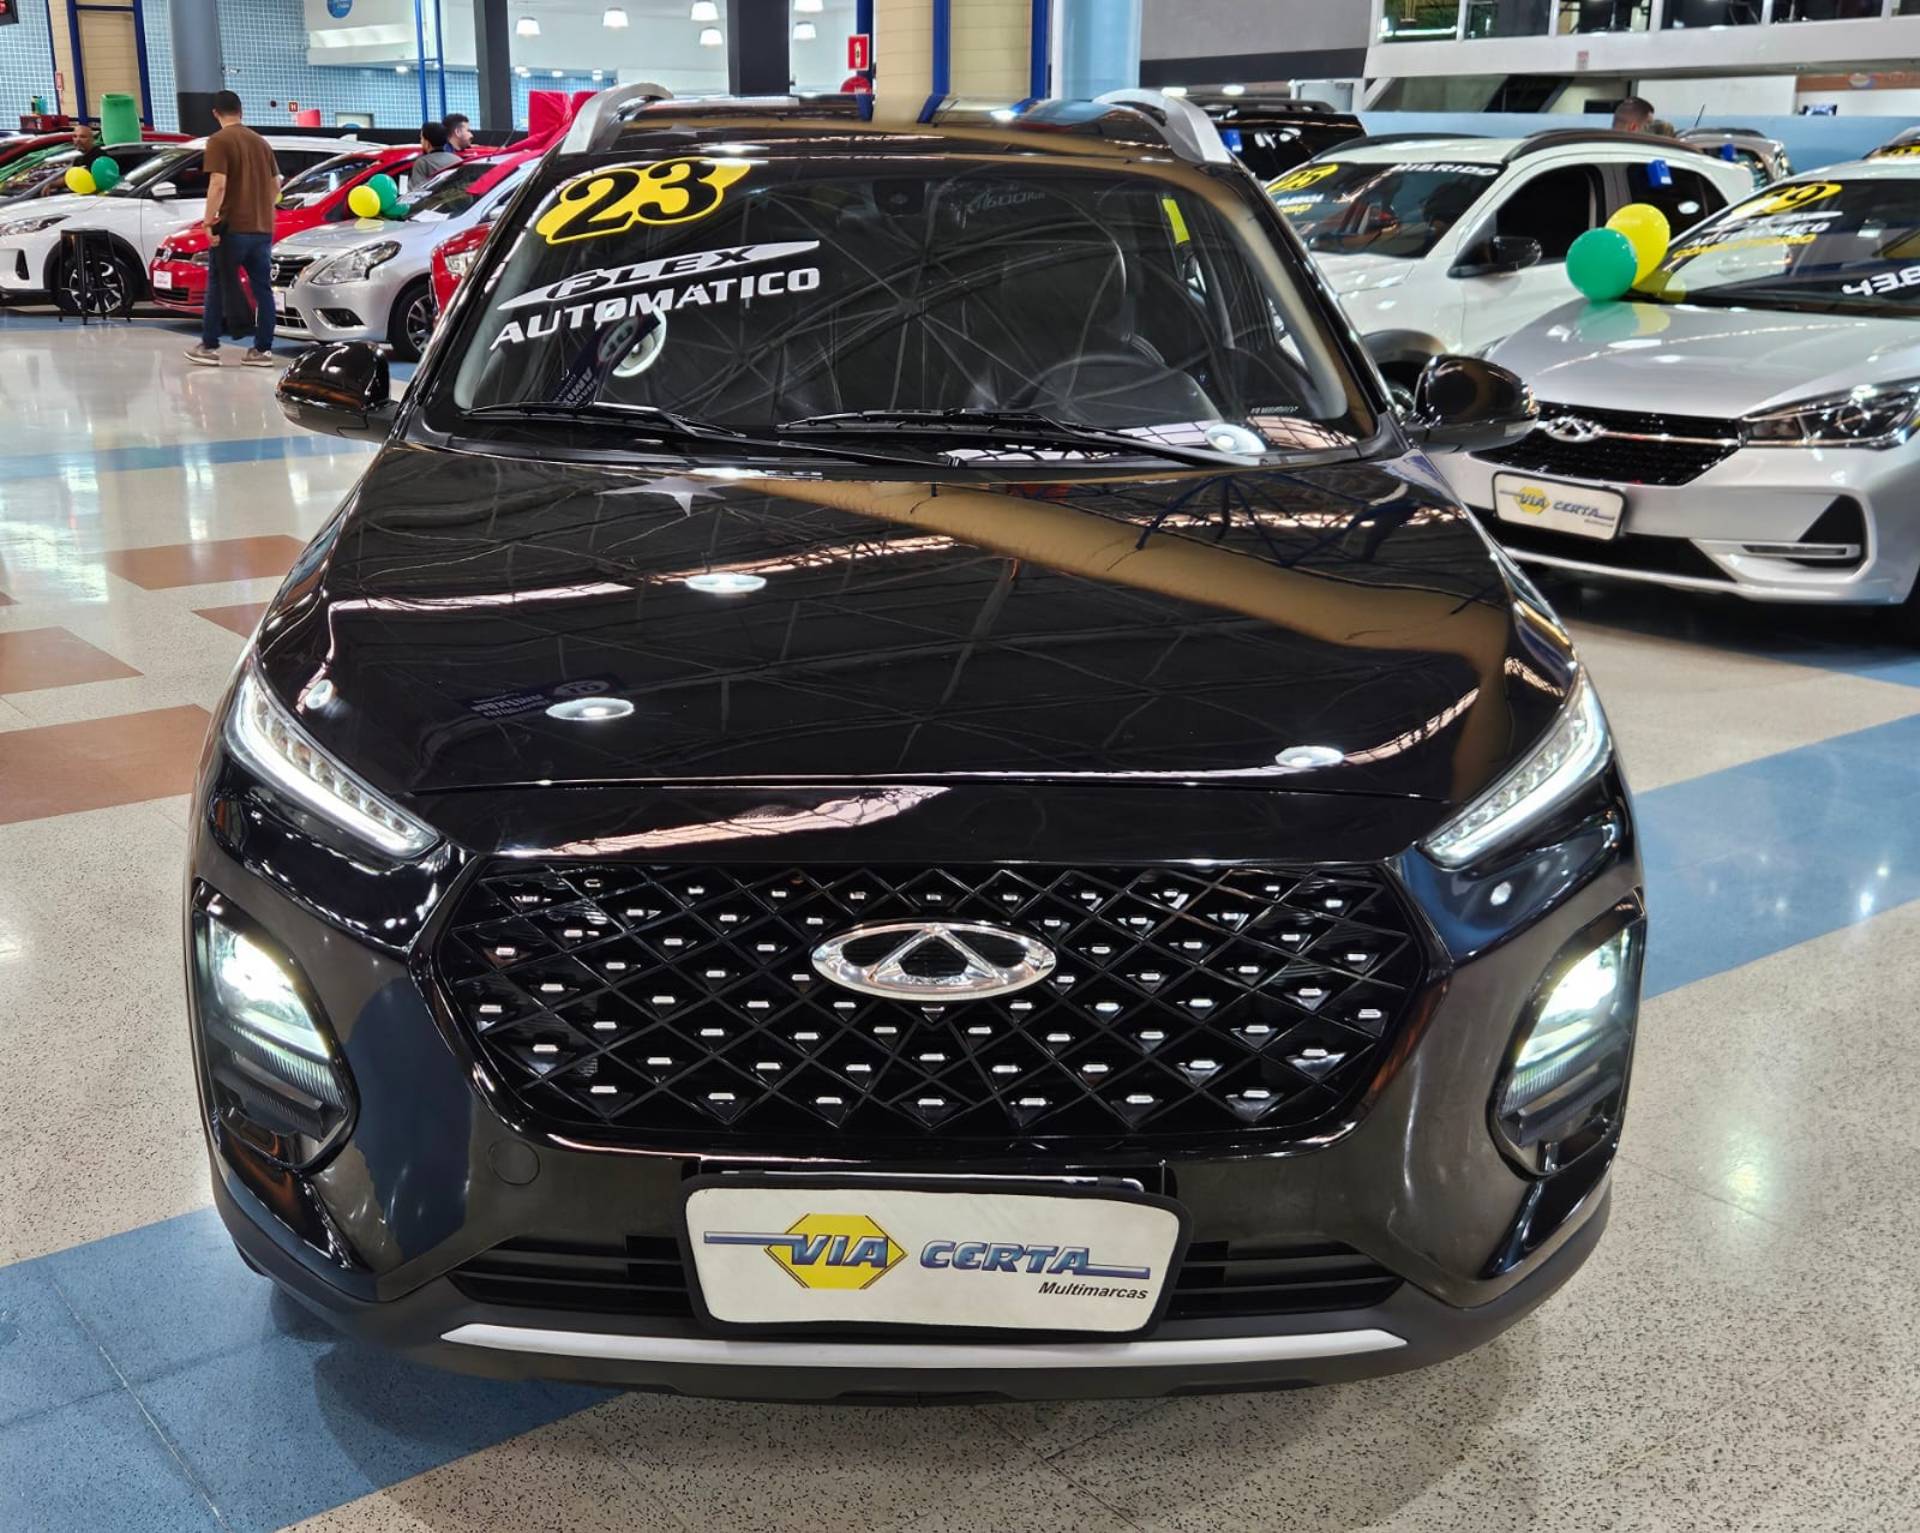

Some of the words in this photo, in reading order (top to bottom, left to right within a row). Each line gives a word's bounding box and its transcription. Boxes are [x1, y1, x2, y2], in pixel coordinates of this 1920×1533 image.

[549, 157, 720, 243] 23
[547, 246, 758, 299] FLEX
[489, 267, 820, 351] AUTOMATICO
[1519, 493, 1547, 507] VIA
[1553, 501, 1602, 517] CERTA
[787, 1233, 889, 1269] VIA
[919, 1239, 1092, 1275] CERTA
[1038, 1281, 1150, 1300] Multimarcas
